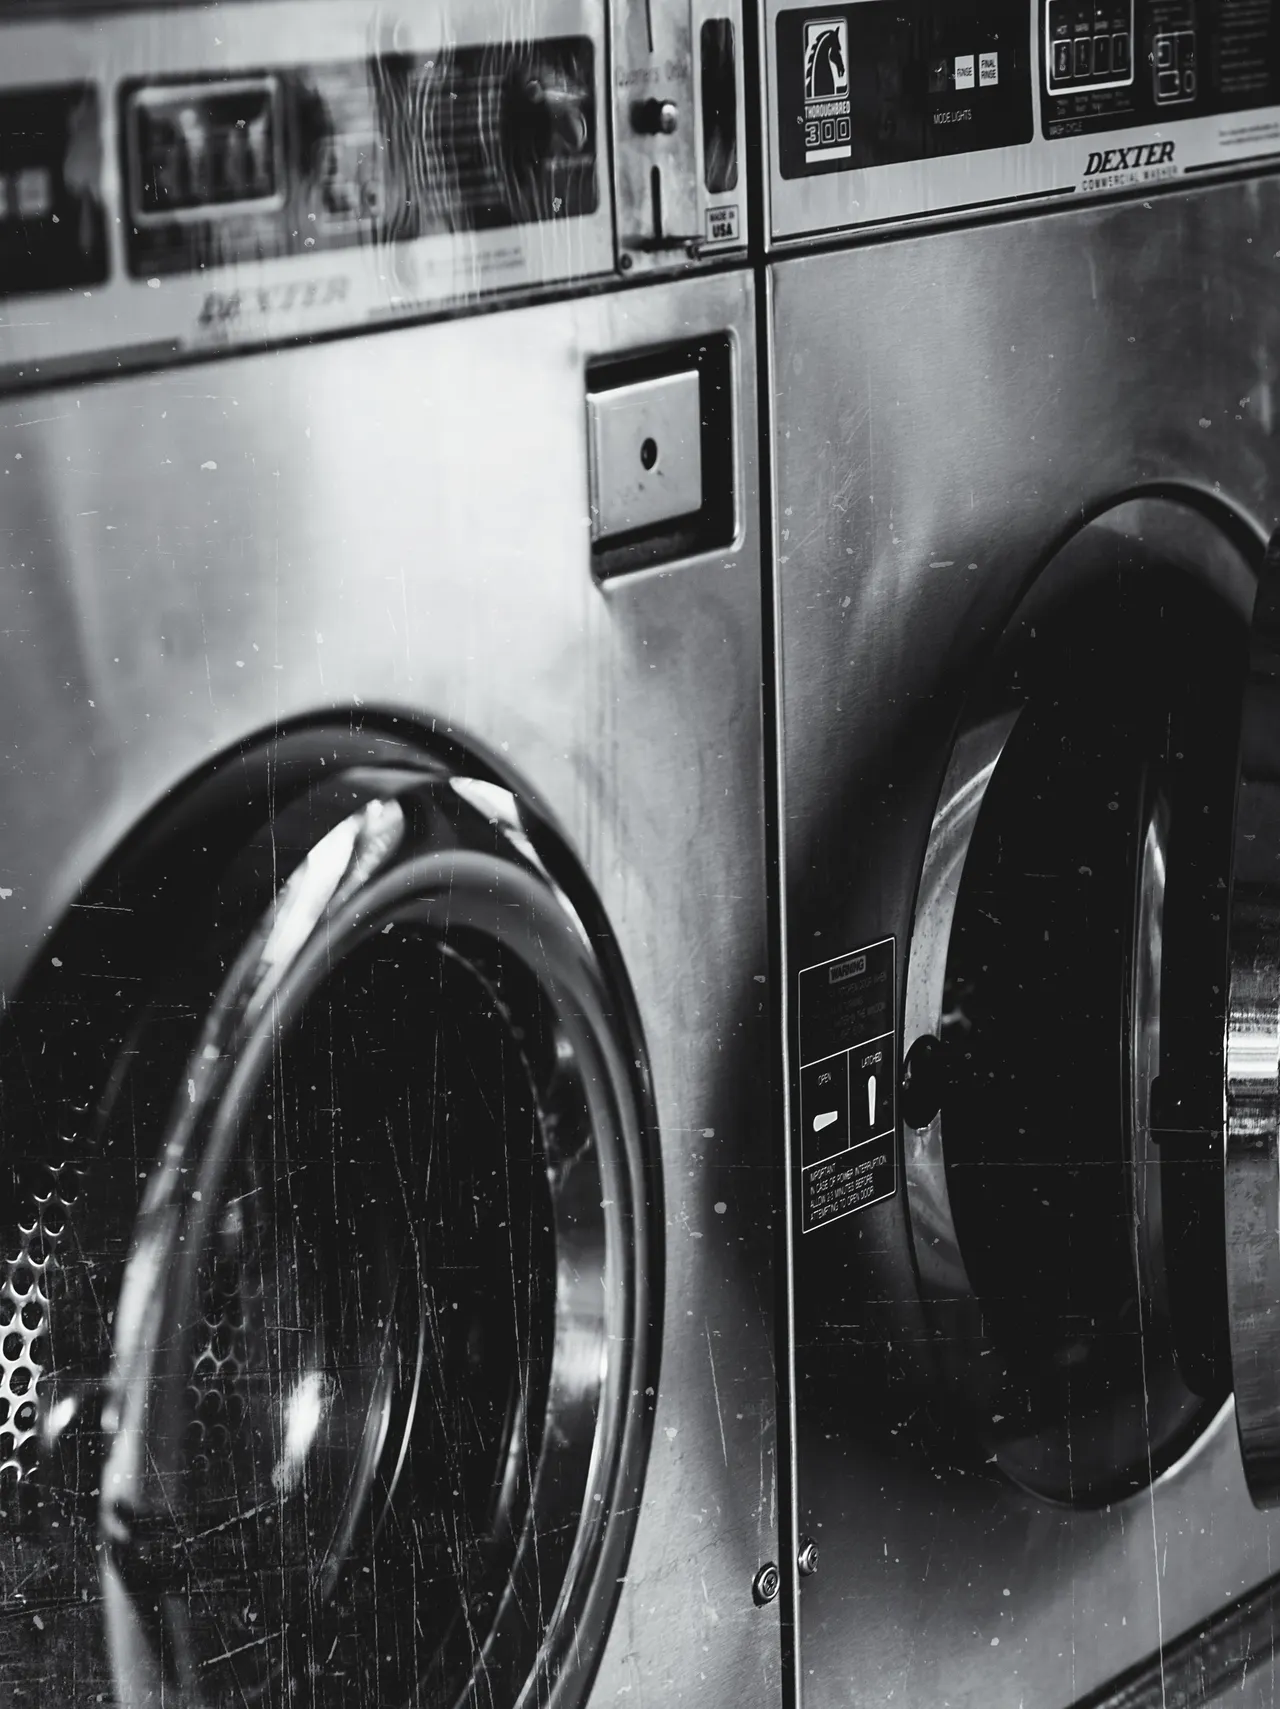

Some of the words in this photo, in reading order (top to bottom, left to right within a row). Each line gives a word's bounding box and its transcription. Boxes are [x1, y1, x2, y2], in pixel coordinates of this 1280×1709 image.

[804, 100, 851, 119] THOROUGHBRED
[933, 111, 951, 124] MODE
[951, 108, 972, 122] LIGHTS
[805, 116, 852, 147] 300
[1083, 140, 1176, 176] DEXTER
[1082, 173, 1139, 192] COMMERCIAL
[712, 222, 733, 238] USA
[861, 1051, 883, 1069] LATCHED
[817, 1071, 832, 1086] OPEN
[810, 1162, 836, 1183] IMPORTANT
[816, 1179, 829, 1194] CASE
[829, 1176, 836, 1188] OF
[837, 1168, 854, 1183] POWER
[855, 1154, 887, 1176] INTERRUPTION
[810, 1195, 826, 1209] ALLOW
[834, 1181, 854, 1199] MINUTES
[855, 1172, 874, 1190] BEFORE
[810, 1201, 839, 1222] ATTEMPTING
[839, 1197, 847, 1208] TO
[847, 1192, 860, 1206] OPEN
[860, 1185, 875, 1201] DOOR
